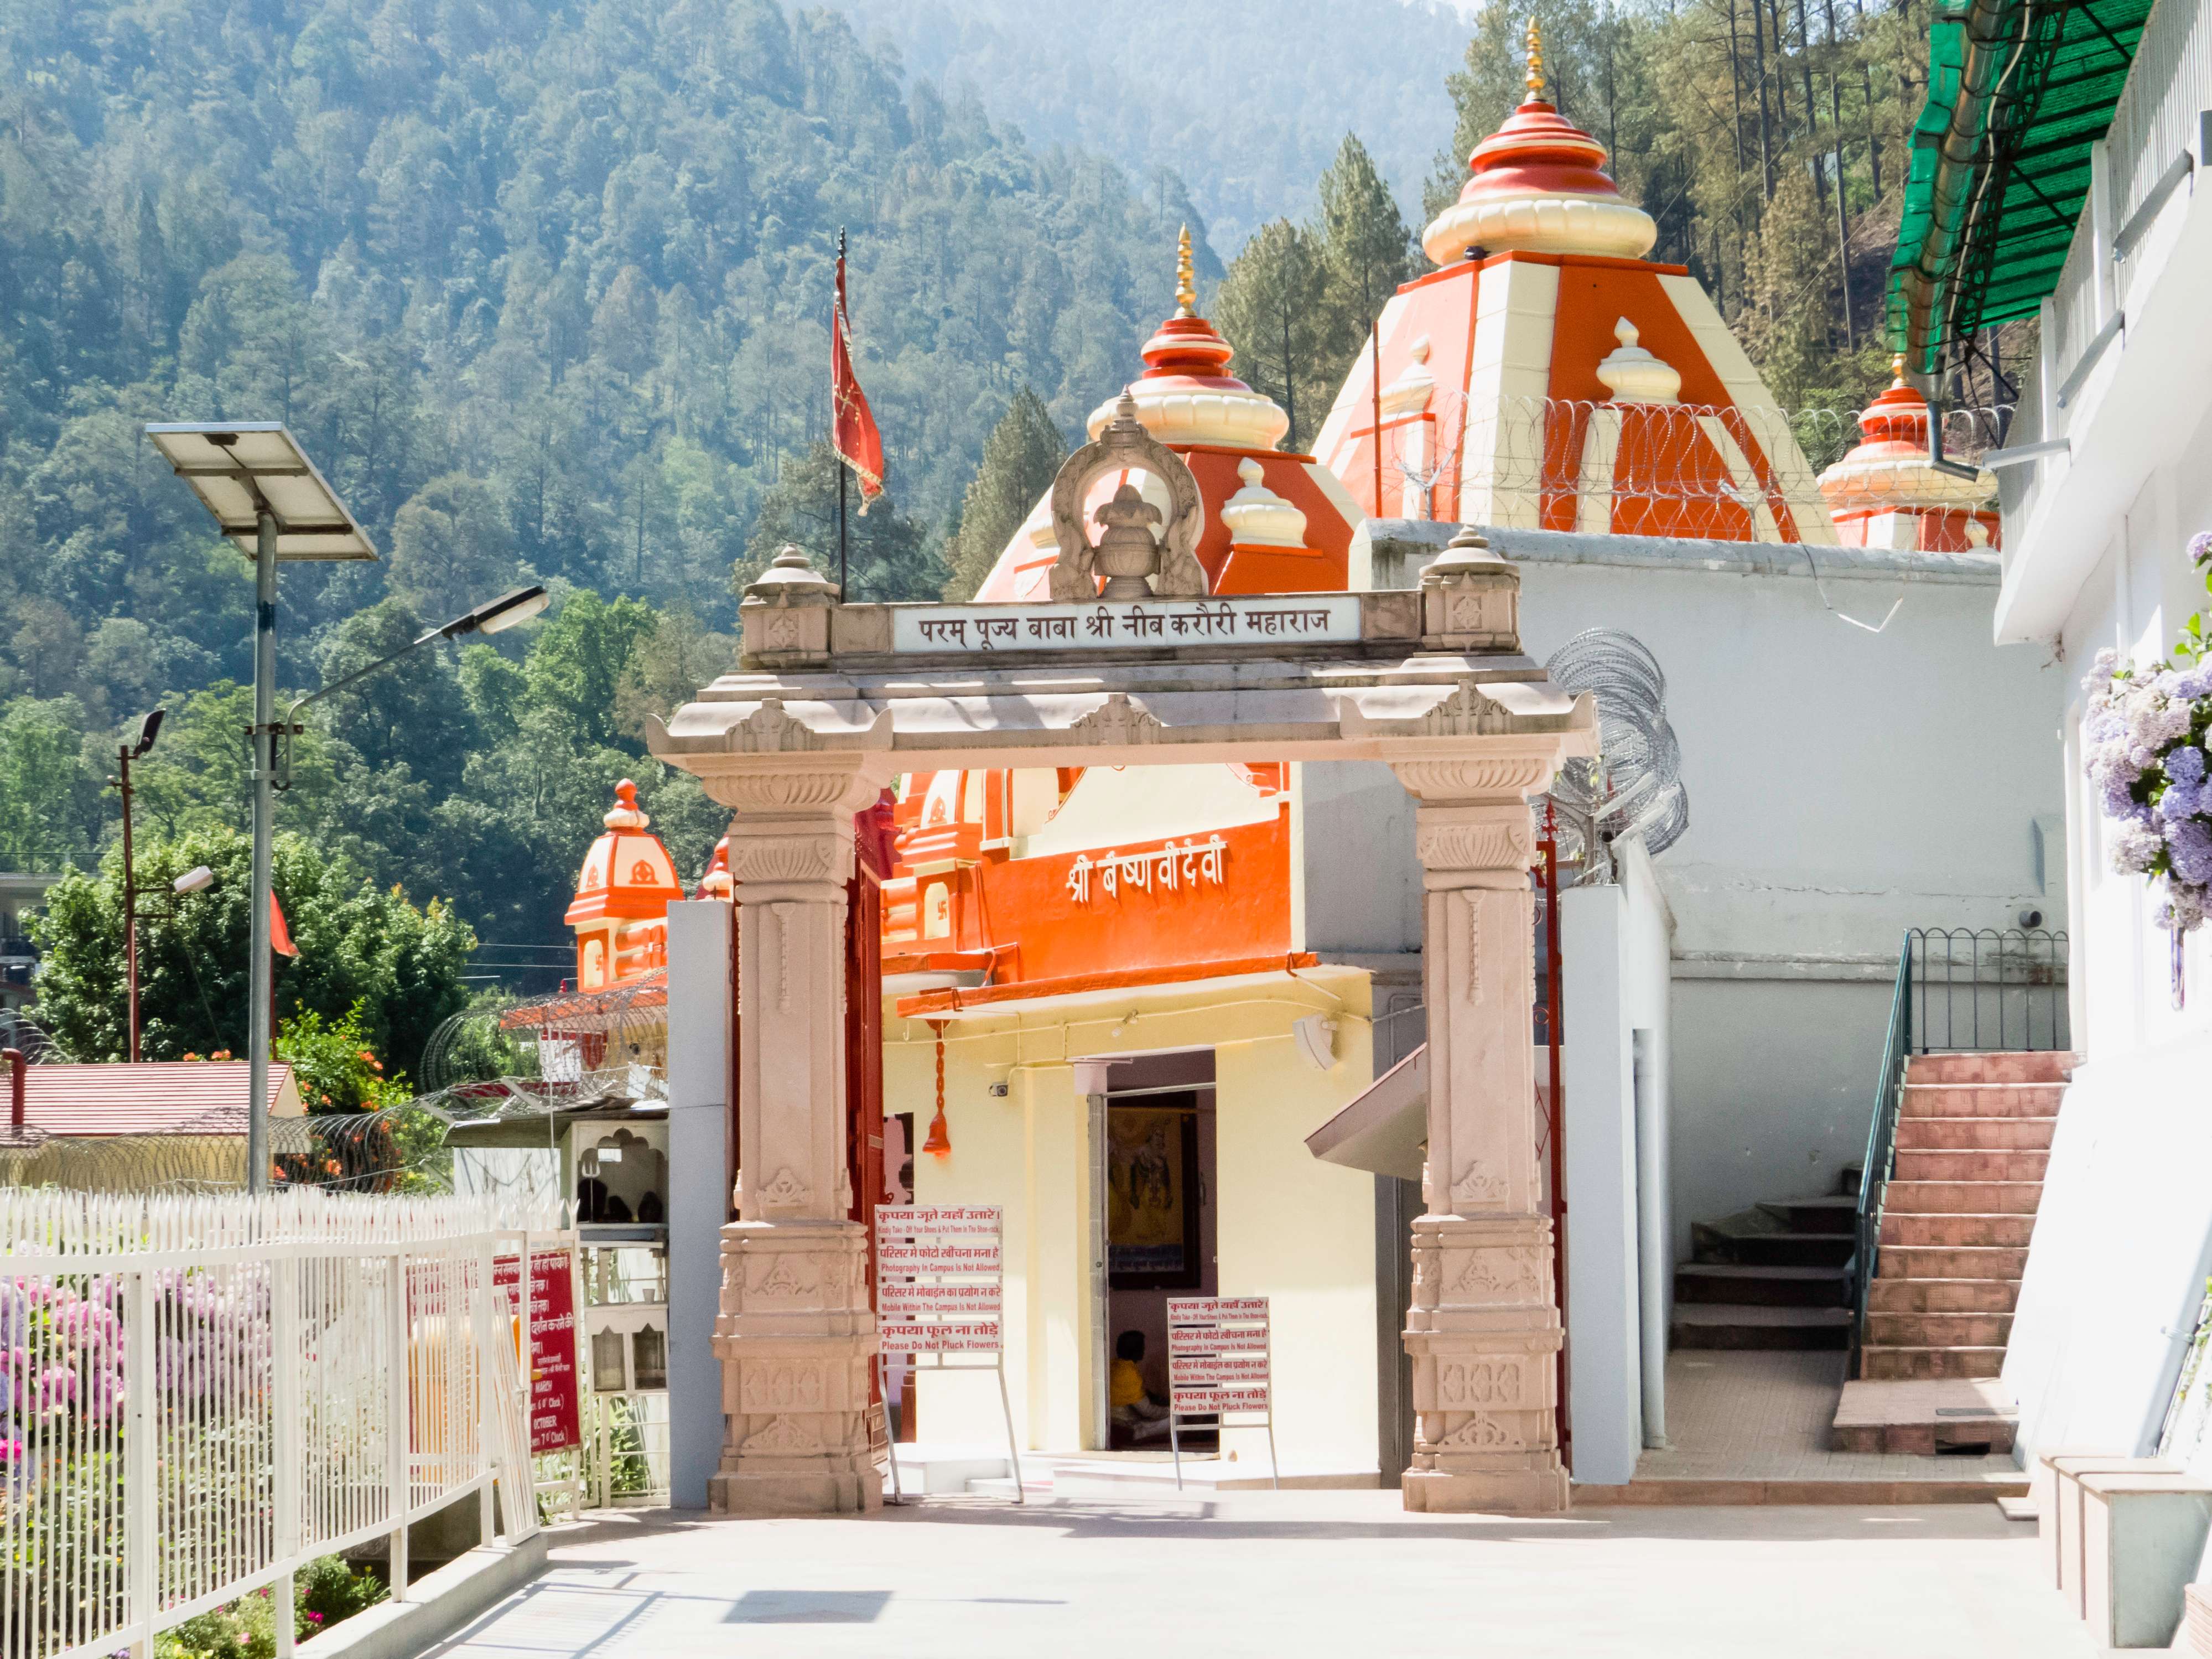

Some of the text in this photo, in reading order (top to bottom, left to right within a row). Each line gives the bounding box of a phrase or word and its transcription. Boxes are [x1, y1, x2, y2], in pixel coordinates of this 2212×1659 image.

[918, 602, 1331, 650] परम् पूज्य बाबा श्री नीब करौरी महाराज
[1066, 854, 1094, 903] श्री
[877, 1211, 915, 1223] कृपया
[917, 1209, 938, 1223] जूते
[880, 1246, 908, 1258] परिसर
[919, 1246, 939, 1258] फोटो
[974, 1248, 990, 1258] मना
[881, 1263, 920, 1274] Photography
[930, 1263, 954, 1273] Campus
[882, 1284, 906, 1297] परिसर
[947, 1288, 957, 1297] का
[980, 1288, 986, 1297] न
[882, 1303, 901, 1311] Mobile
[903, 1303, 921, 1311] Within
[923, 1303, 933, 1311] The
[935, 1303, 957, 1312] Campus
[967, 1303, 976, 1311] Not
[978, 1303, 1000, 1311] Allowed
[1170, 1303, 1200, 1313] कृपया
[1201, 1300, 1218, 1311] जूते
[881, 1326, 923, 1339] कृपया
[926, 1325, 953, 1338] फूल
[955, 1325, 971, 1335] ना
[1172, 1330, 1194, 1340] परिसर
[882, 1340, 998, 1350] Please Do Not Pluck Flowers
[1173, 1392, 1206, 1402] कृपया
[1209, 1392, 1230, 1402] फूल
